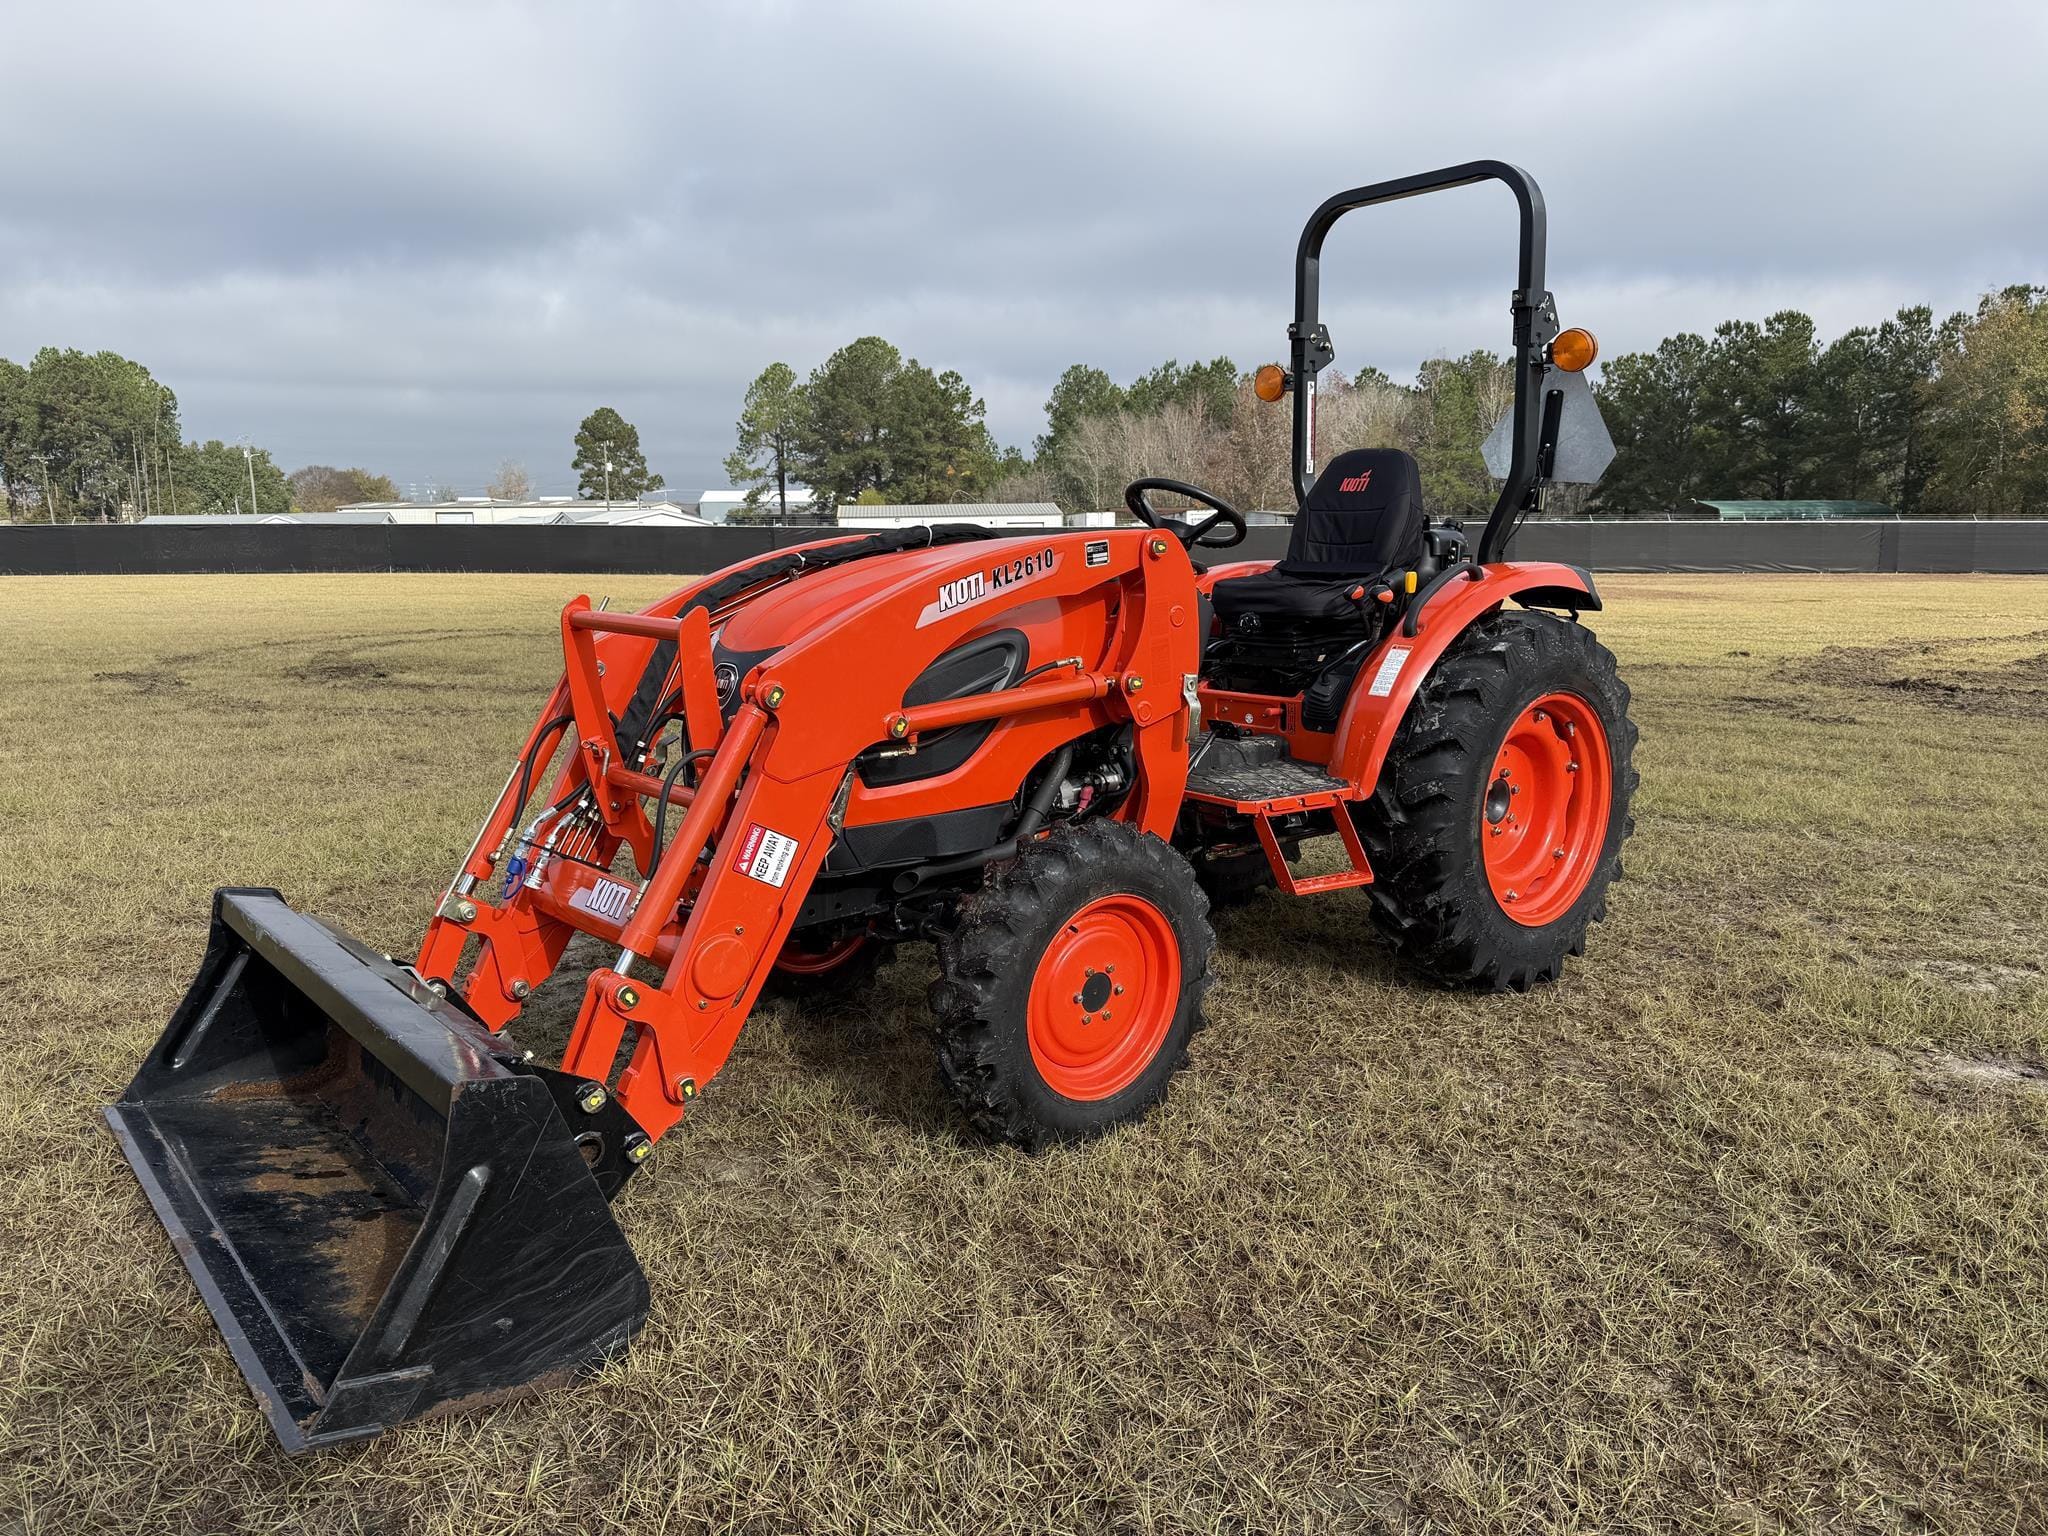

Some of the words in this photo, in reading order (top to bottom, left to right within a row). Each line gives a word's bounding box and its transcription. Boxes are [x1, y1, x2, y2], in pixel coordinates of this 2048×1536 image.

[1339, 477, 1371, 492] KIOTI
[938, 569, 985, 612] KIOTI
[993, 549, 1053, 589] KL2610
[742, 826, 761, 860] WARNING
[754, 857, 770, 879] KEEP
[763, 833, 780, 858] AWAY
[769, 871, 780, 883] from
[776, 851, 790, 872] working
[783, 840, 793, 852] area
[585, 877, 632, 920] KIOTI
